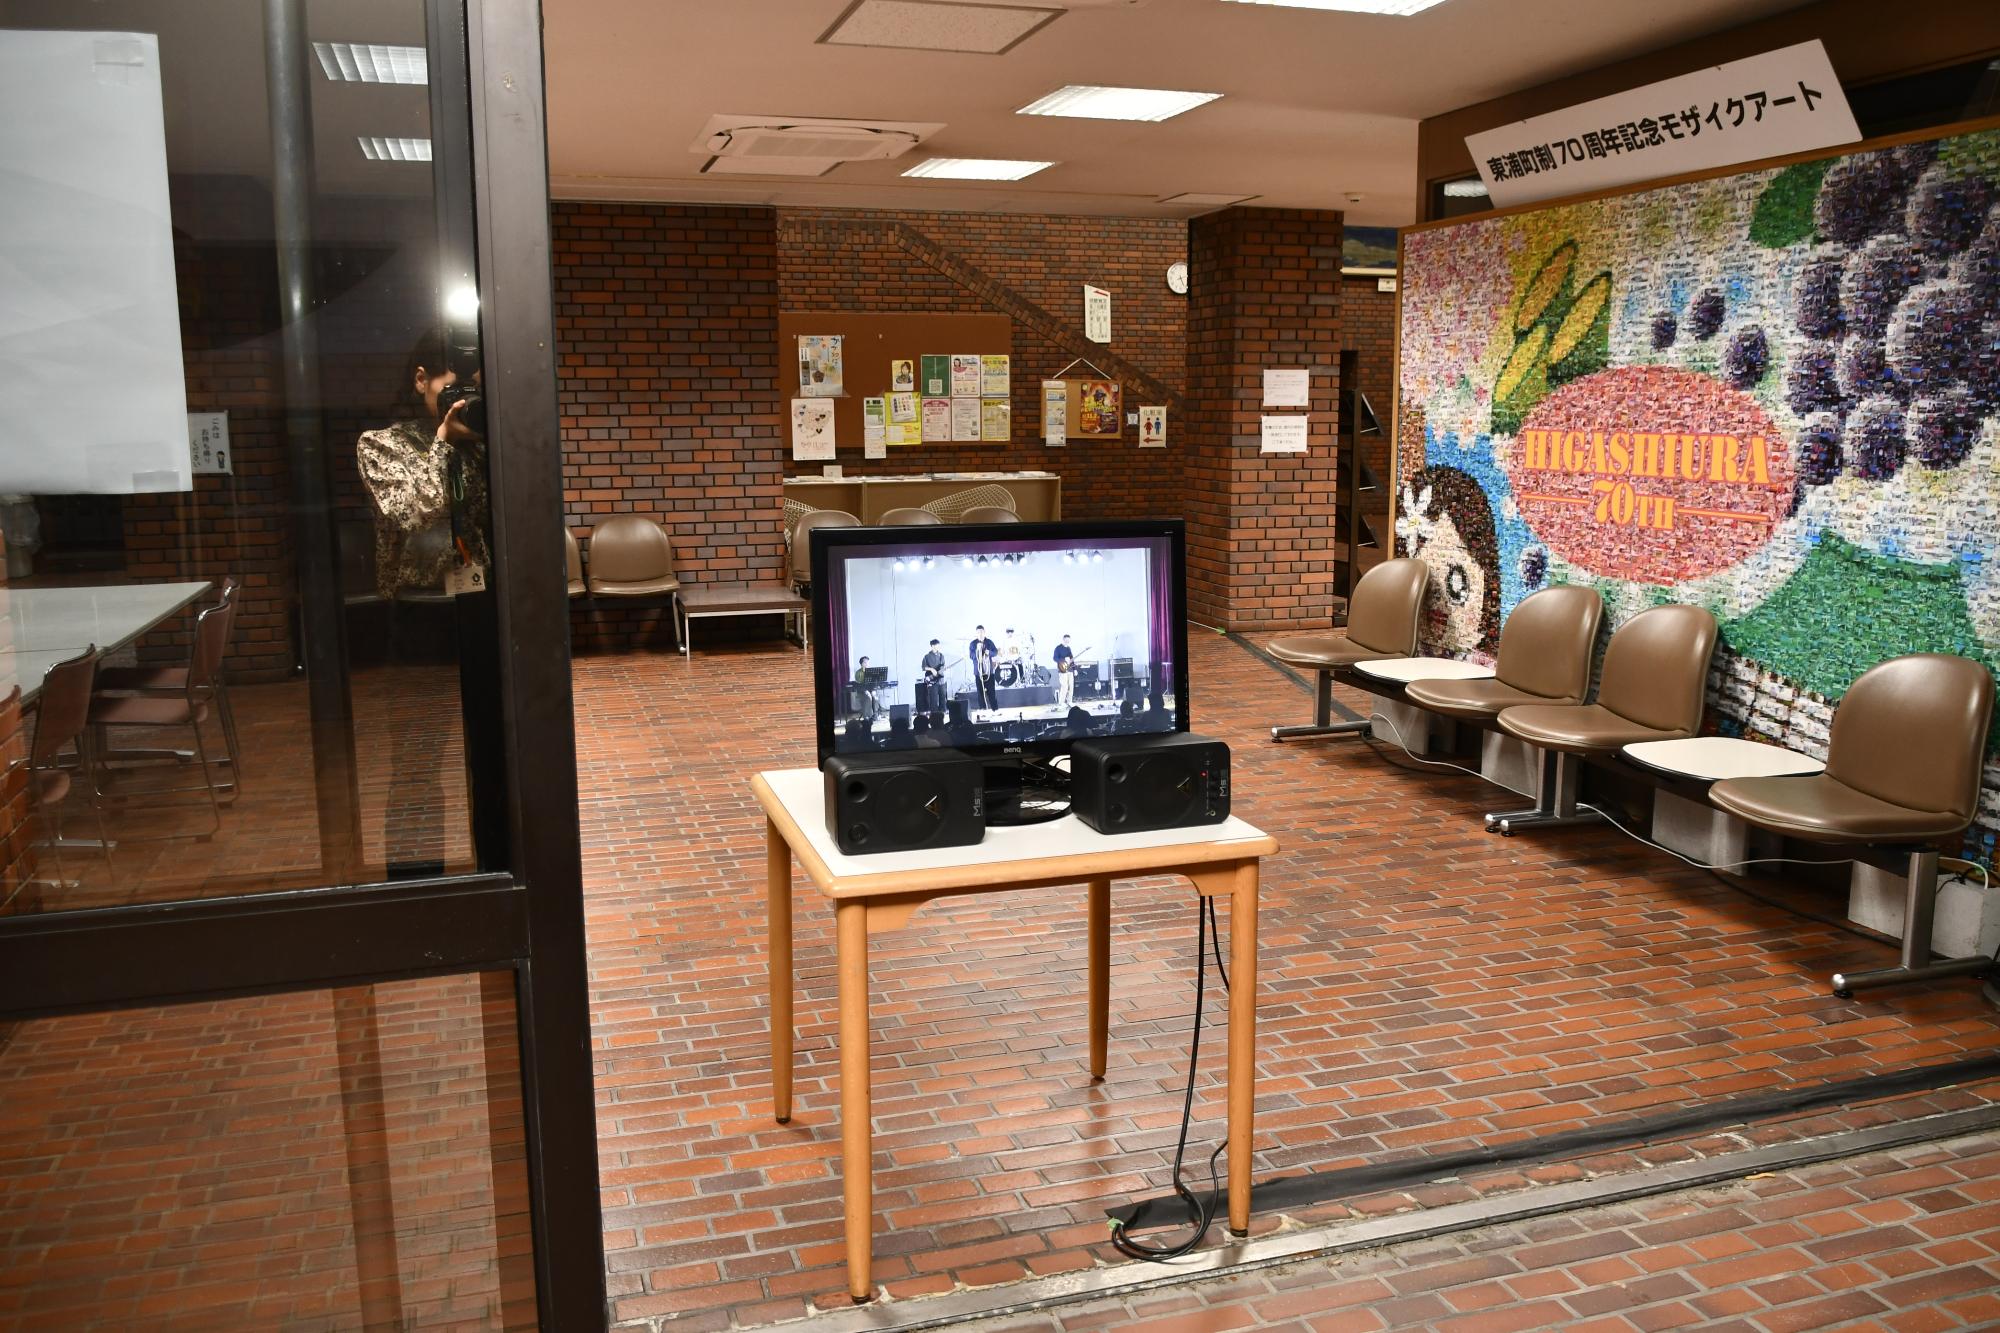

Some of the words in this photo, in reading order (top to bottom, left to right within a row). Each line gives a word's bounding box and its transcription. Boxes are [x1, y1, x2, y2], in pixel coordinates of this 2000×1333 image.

[1487, 81, 1822, 182] 東浦町制70周年記念モザイクアート
[1524, 430, 1770, 484] HIGASHIURA
[1593, 479, 1676, 530] 70TH
[1003, 746, 1022, 754] BenQ
